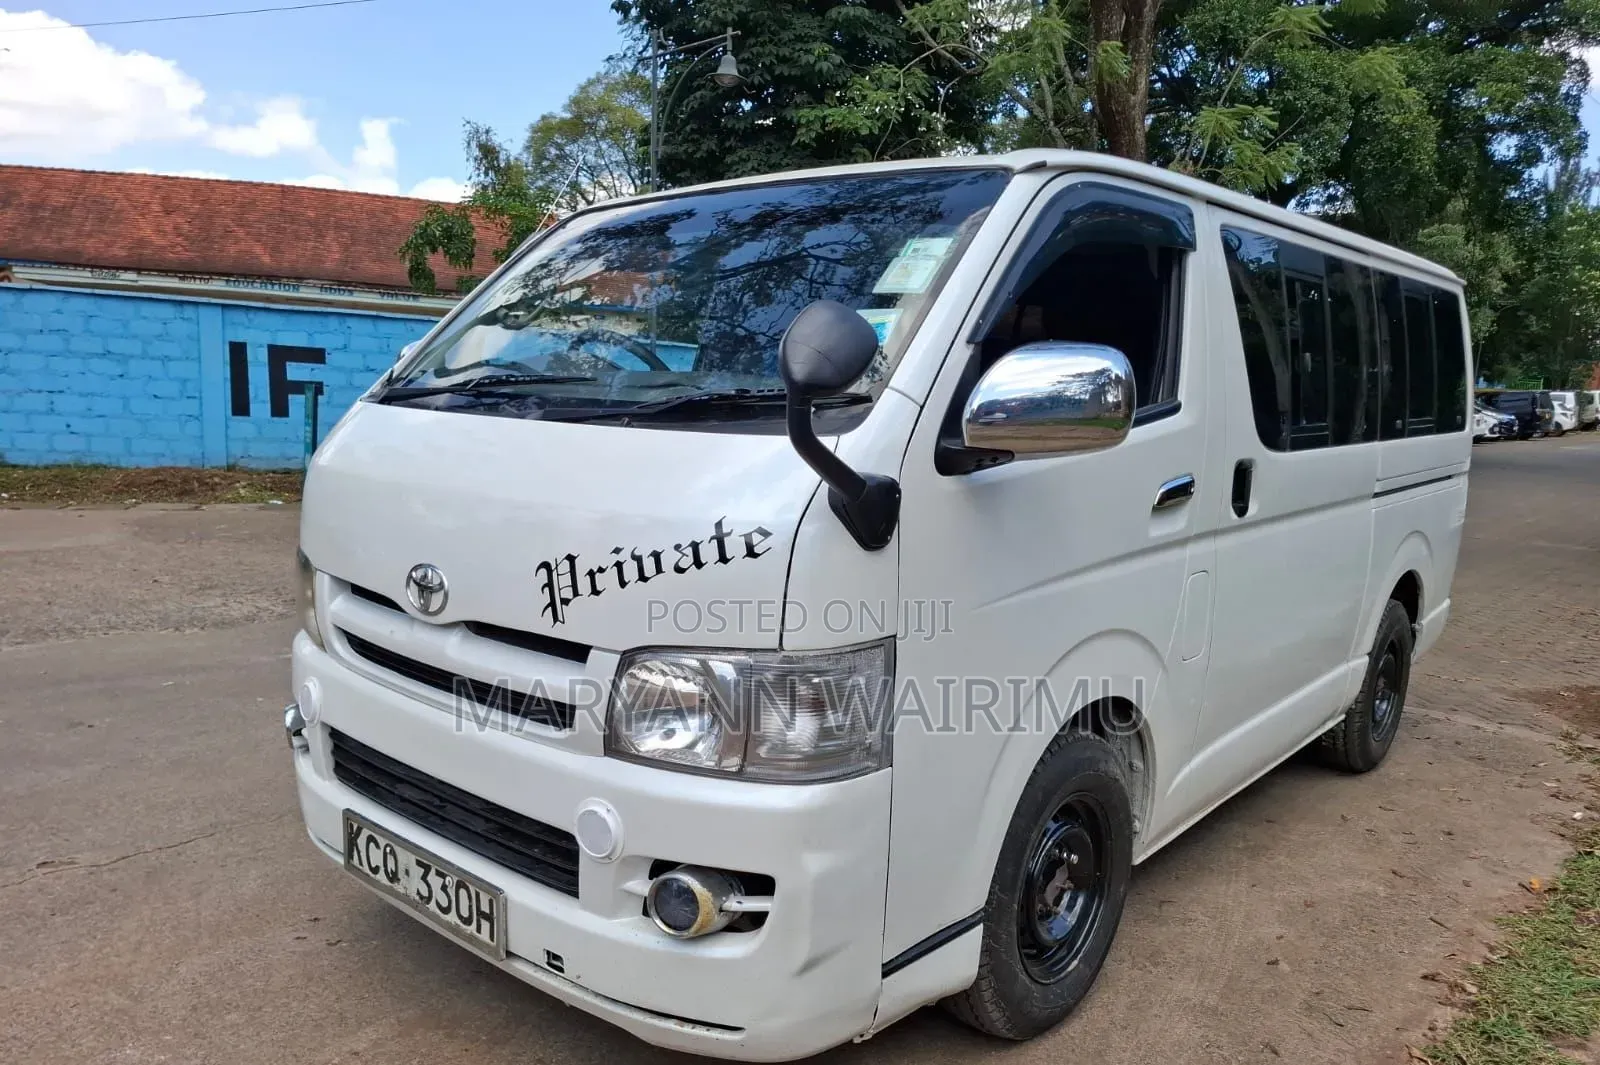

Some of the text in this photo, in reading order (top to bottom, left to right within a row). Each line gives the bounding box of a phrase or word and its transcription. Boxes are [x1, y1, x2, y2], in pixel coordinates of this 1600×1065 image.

[229, 341, 327, 418] IF
[534, 515, 774, 629] Private
[348, 822, 496, 943] KCQ 330H
